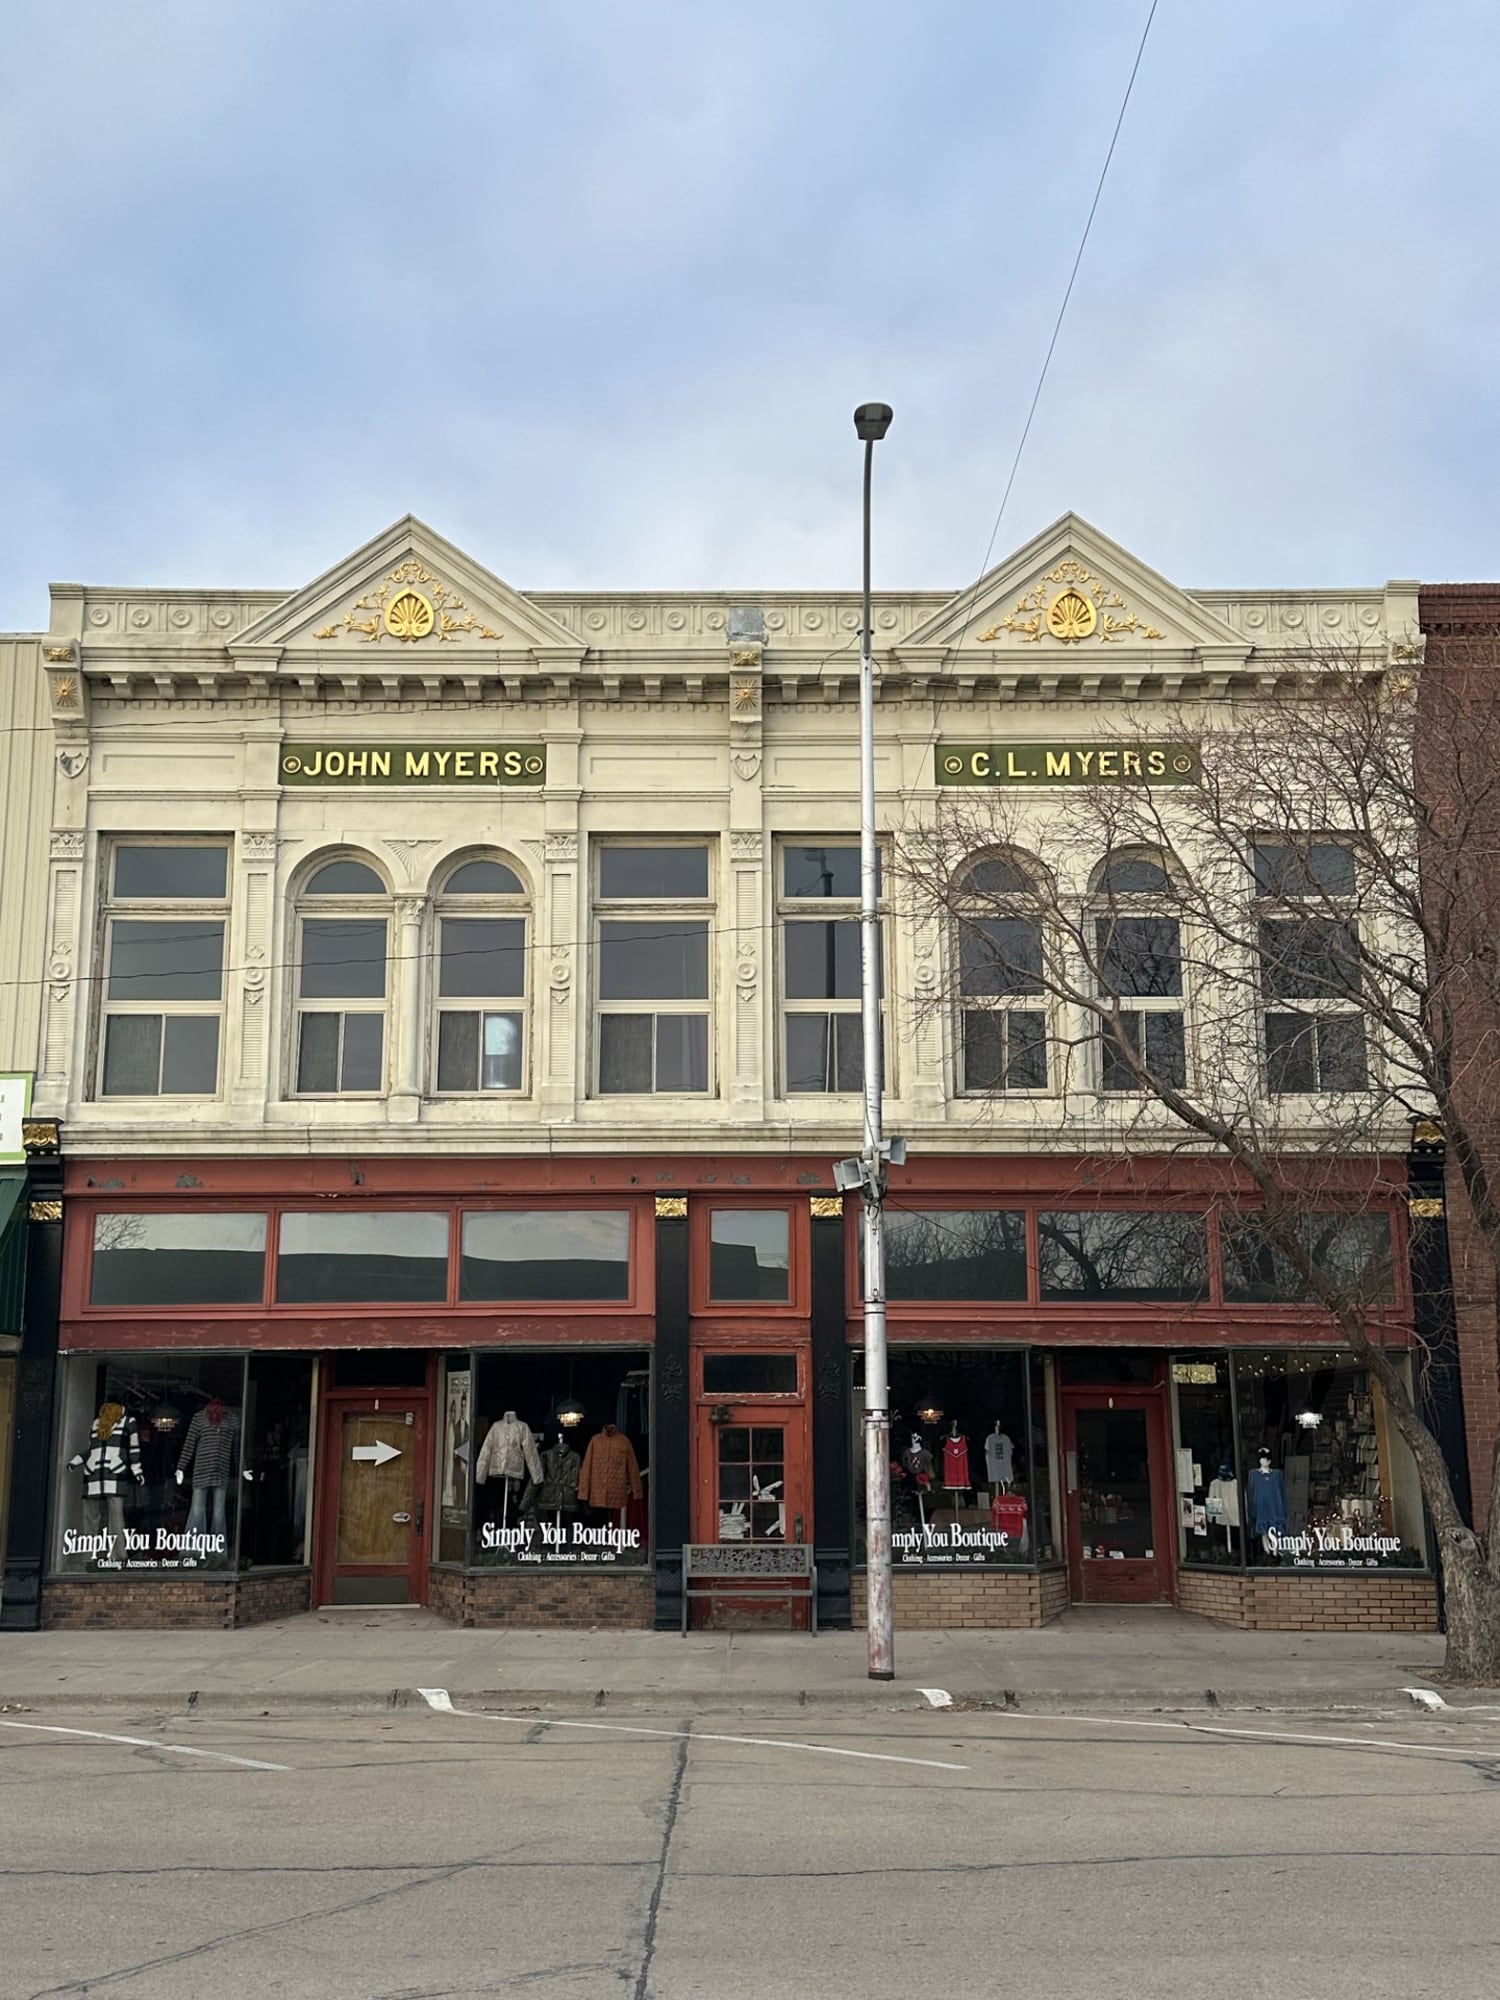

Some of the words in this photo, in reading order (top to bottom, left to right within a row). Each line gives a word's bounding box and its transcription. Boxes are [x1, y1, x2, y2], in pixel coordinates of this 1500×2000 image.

[303, 751, 391, 776] JOHN
[405, 751, 522, 776] MYERS
[1046, 751, 1166, 776] MYERS
[63, 1527, 118, 1559] Simply
[122, 1528, 150, 1550] You
[156, 1527, 225, 1560] Boutique
[481, 1521, 535, 1553] Simply
[539, 1522, 567, 1545] You
[572, 1521, 640, 1554] Boutique
[891, 1527, 923, 1553] mply
[923, 1523, 948, 1548] You
[950, 1523, 1009, 1552] Boutique
[1268, 1527, 1315, 1556] Simply
[1314, 1527, 1340, 1551] You
[1341, 1526, 1401, 1557] Boutique
[97, 1559, 122, 1570] Clothing
[126, 1558, 158, 1568] Accessories
[162, 1558, 179, 1568] Decor
[182, 1558, 197, 1568] Gifts
[517, 1552, 542, 1563] Clothing
[546, 1552, 577, 1562] Accessories
[580, 1552, 597, 1561] Decor
[601, 1551, 616, 1561] Gifts
